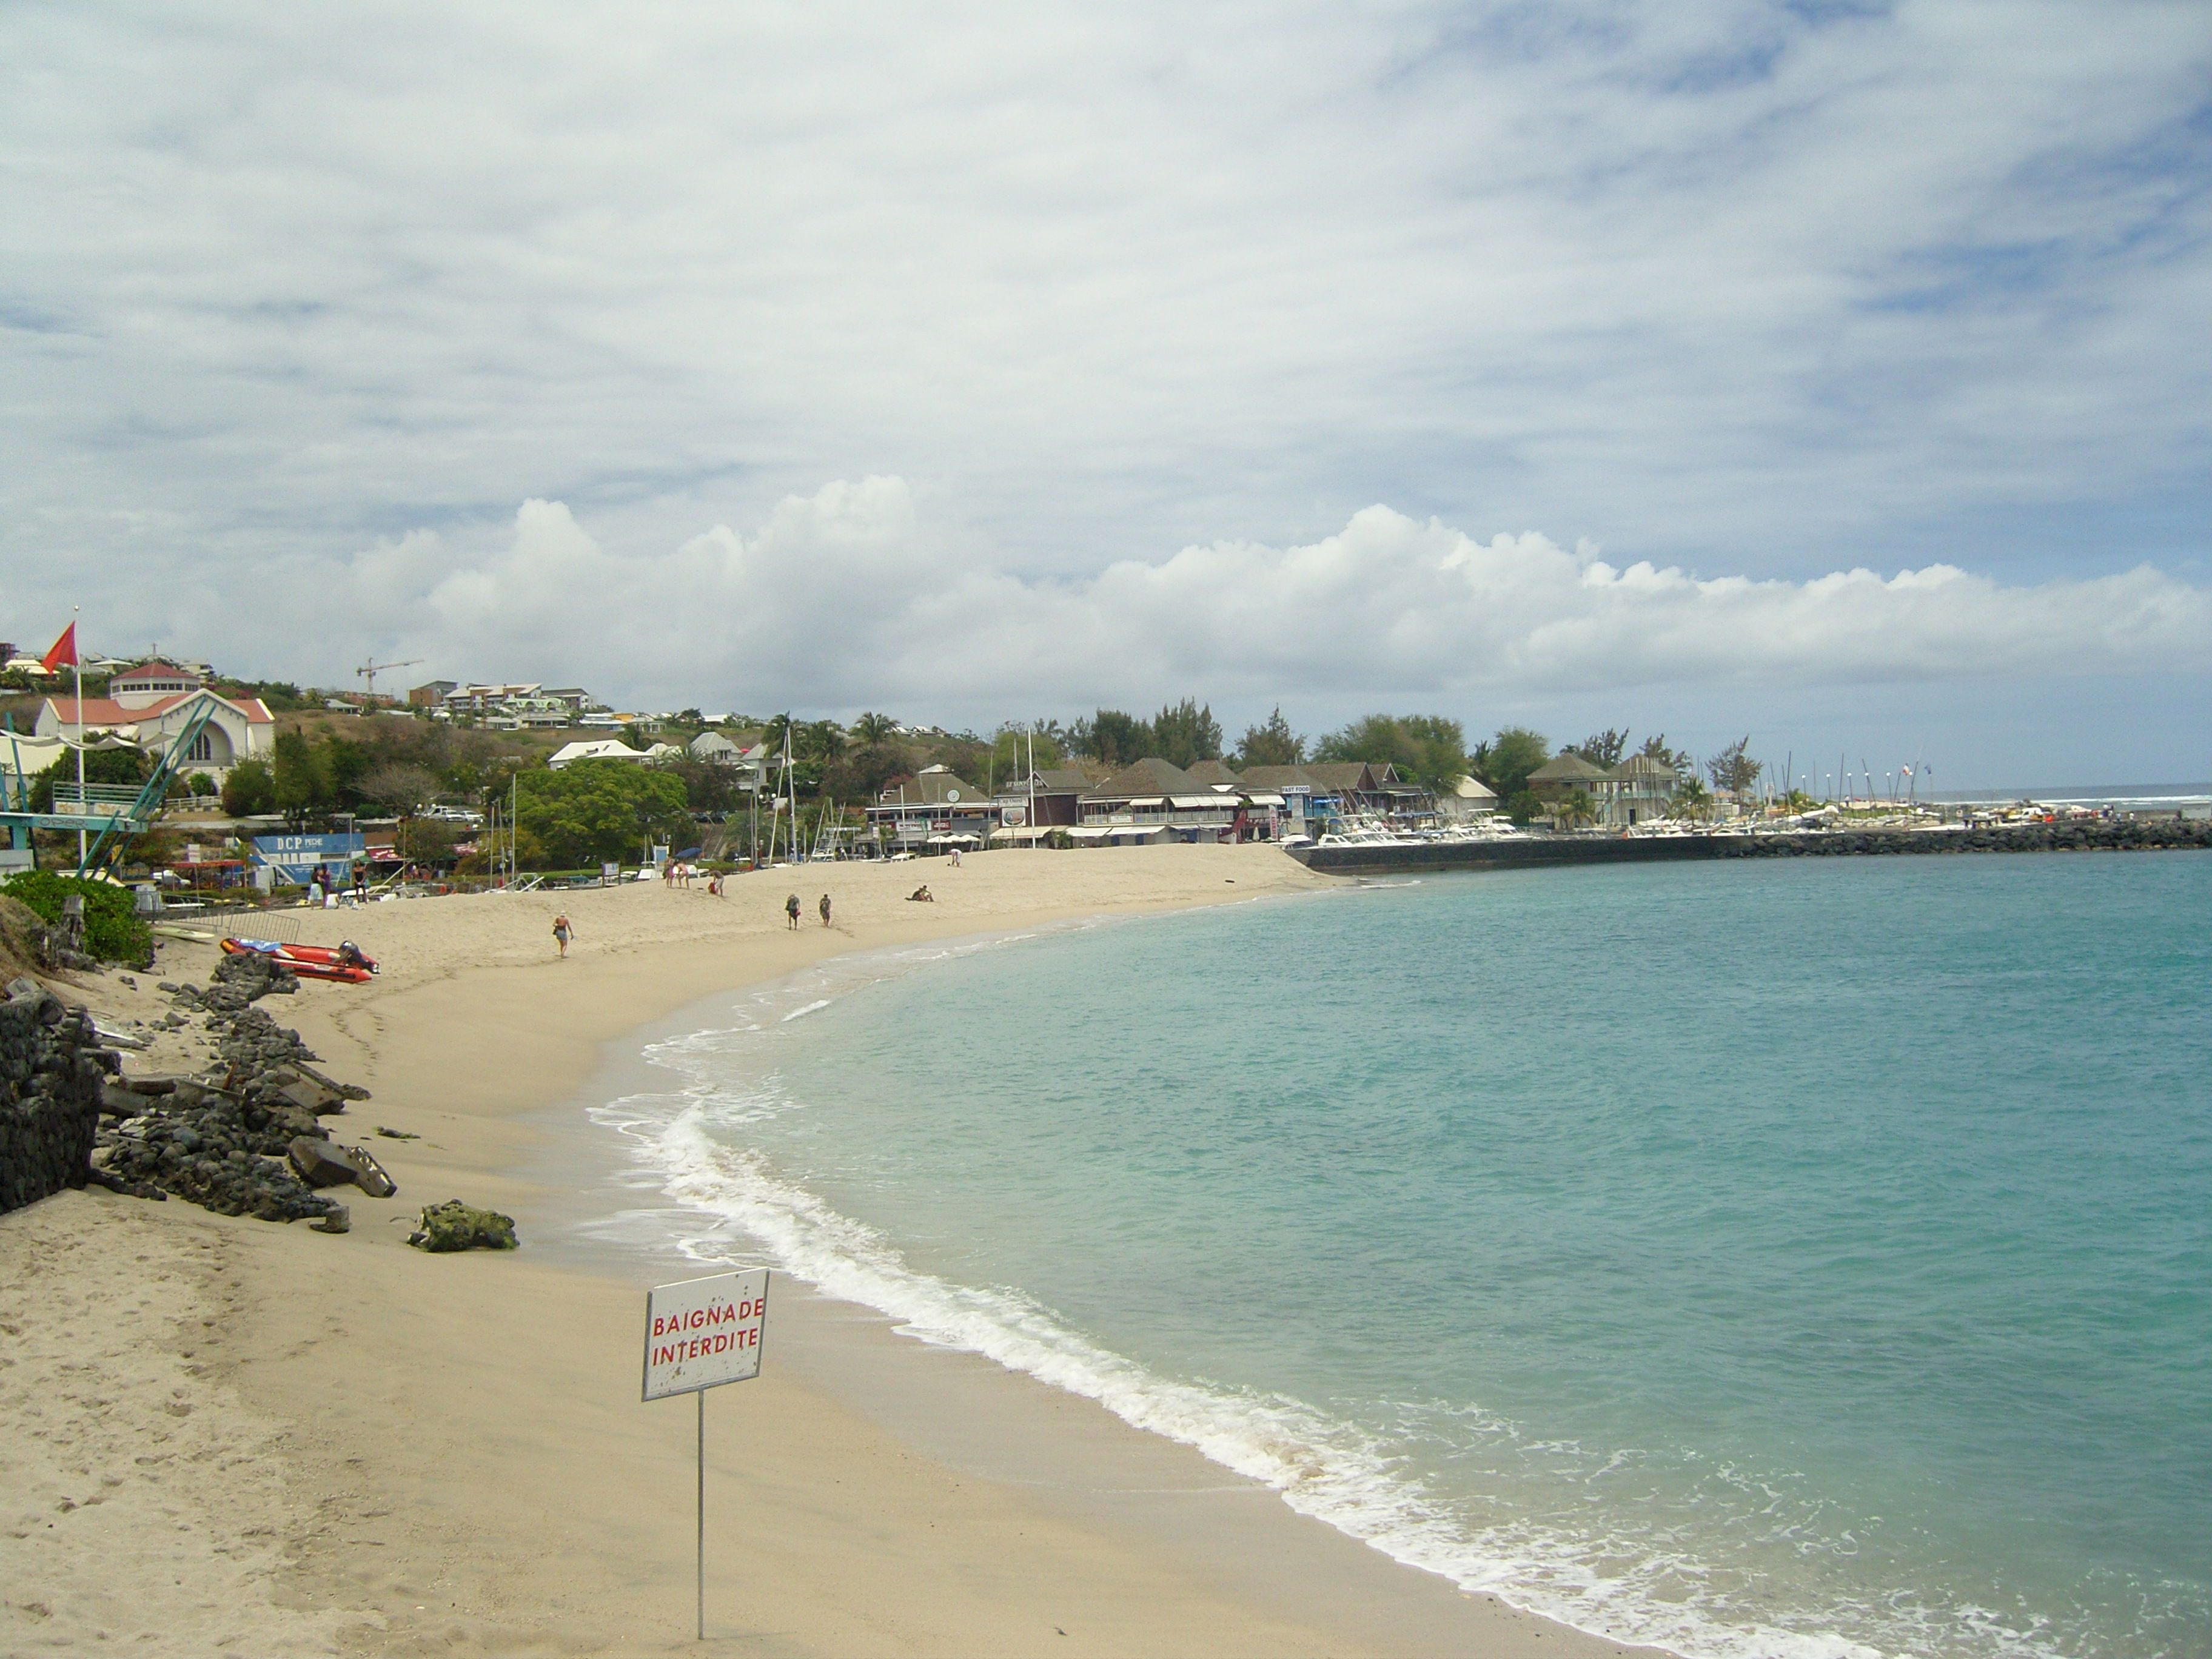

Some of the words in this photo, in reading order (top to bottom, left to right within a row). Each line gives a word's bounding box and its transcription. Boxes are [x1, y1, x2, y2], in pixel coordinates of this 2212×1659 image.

[277, 837, 303, 850] DCP
[653, 1298, 764, 1336] BAIGNADE
[652, 1327, 758, 1366] INTERDITE
